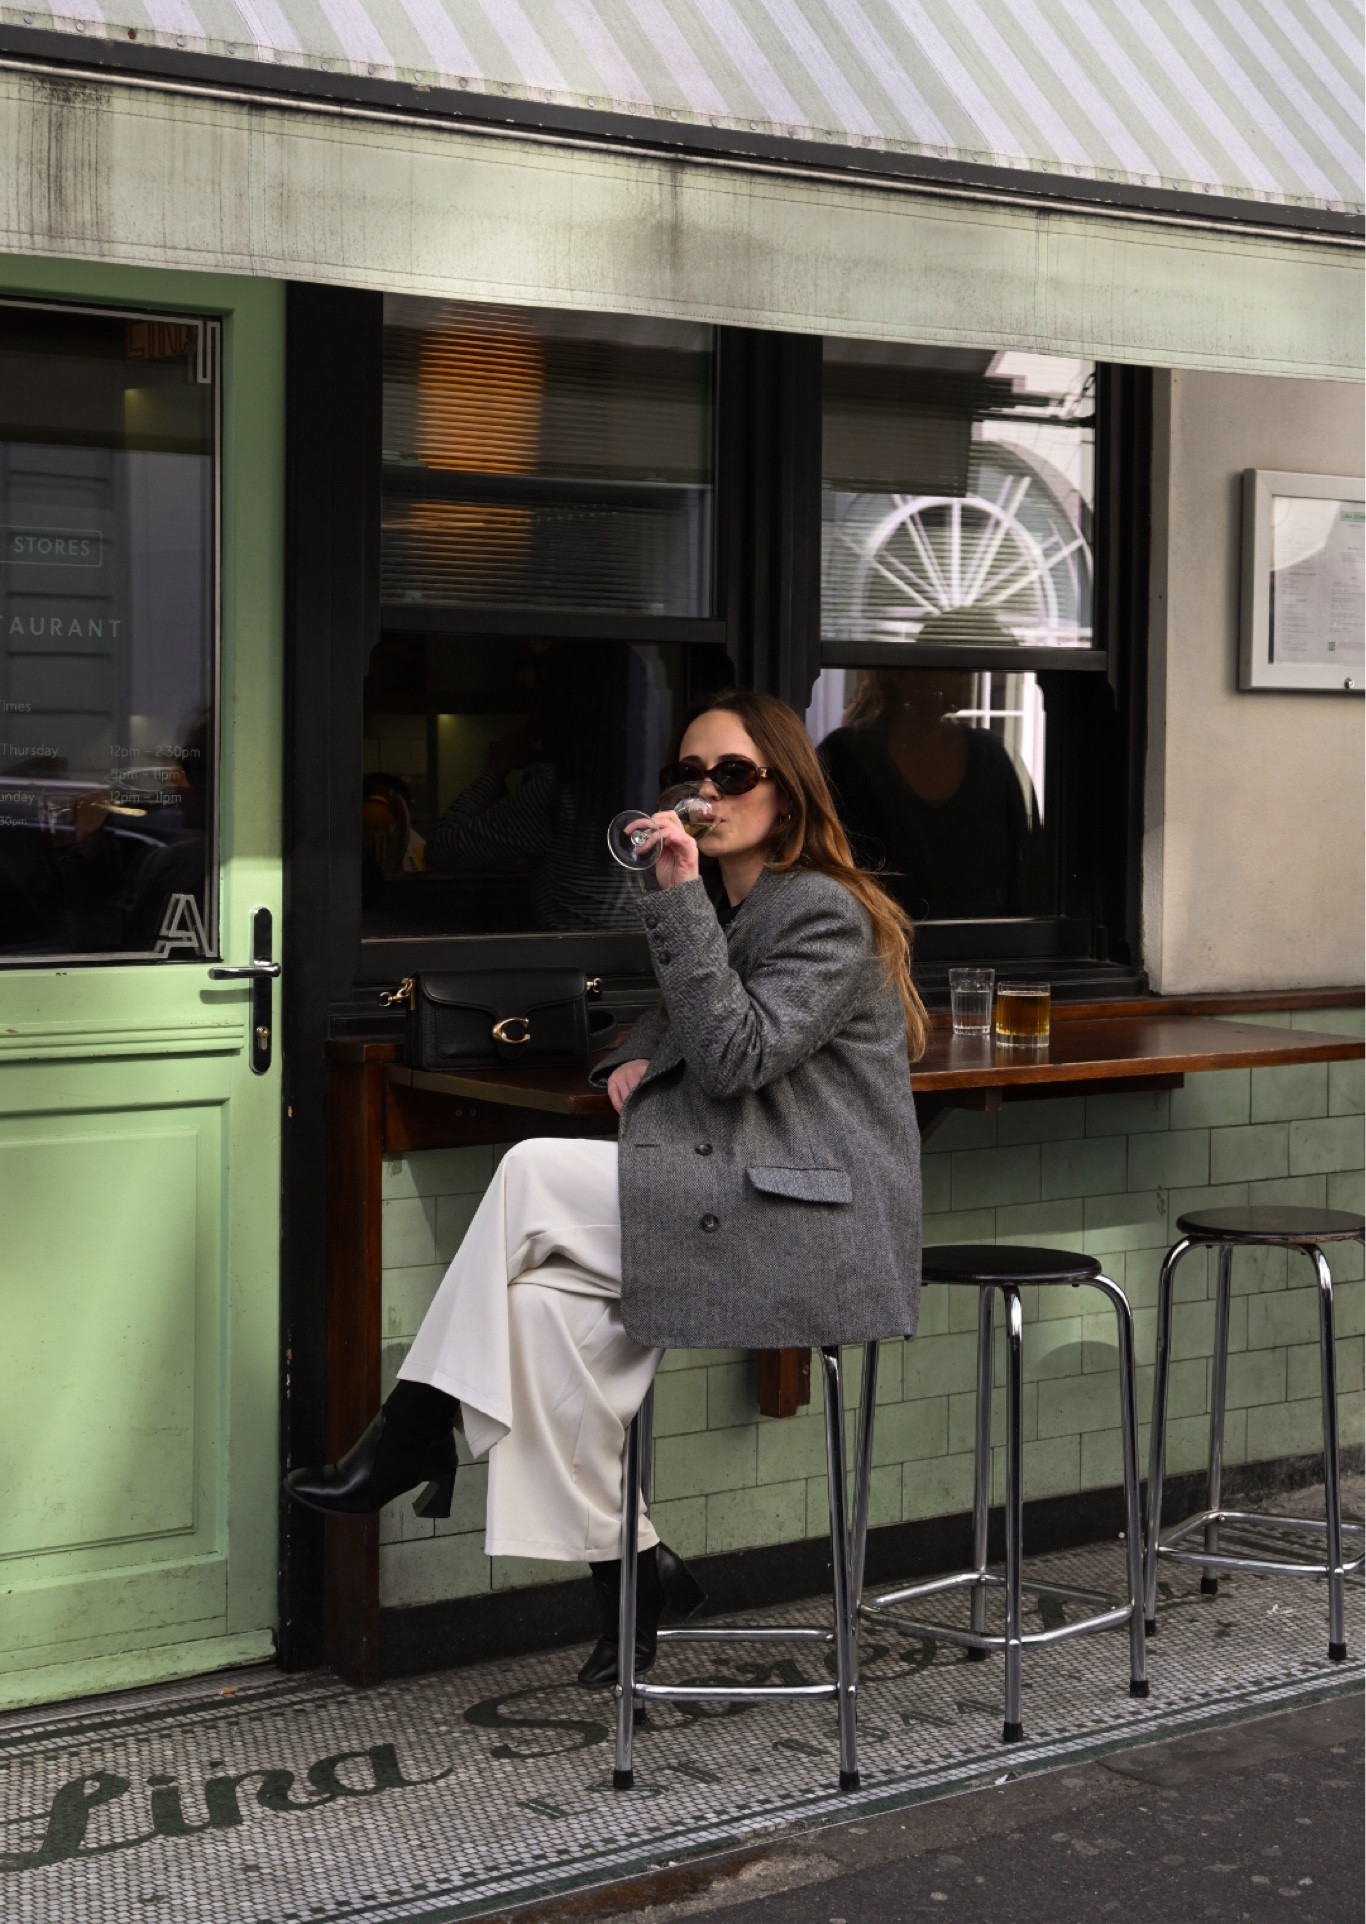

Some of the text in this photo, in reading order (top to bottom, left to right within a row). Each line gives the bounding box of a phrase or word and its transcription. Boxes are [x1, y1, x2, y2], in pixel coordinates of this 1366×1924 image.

[14, 536, 91, 557] STORES
[0, 615, 122, 638] AURANT
[0, 699, 32, 713] imes
[1, 742, 59, 760] Thursday
[110, 745, 140, 759] 12pm
[110, 791, 140, 805] 12pm
[0, 1634, 972, 1872] Lina Sores
